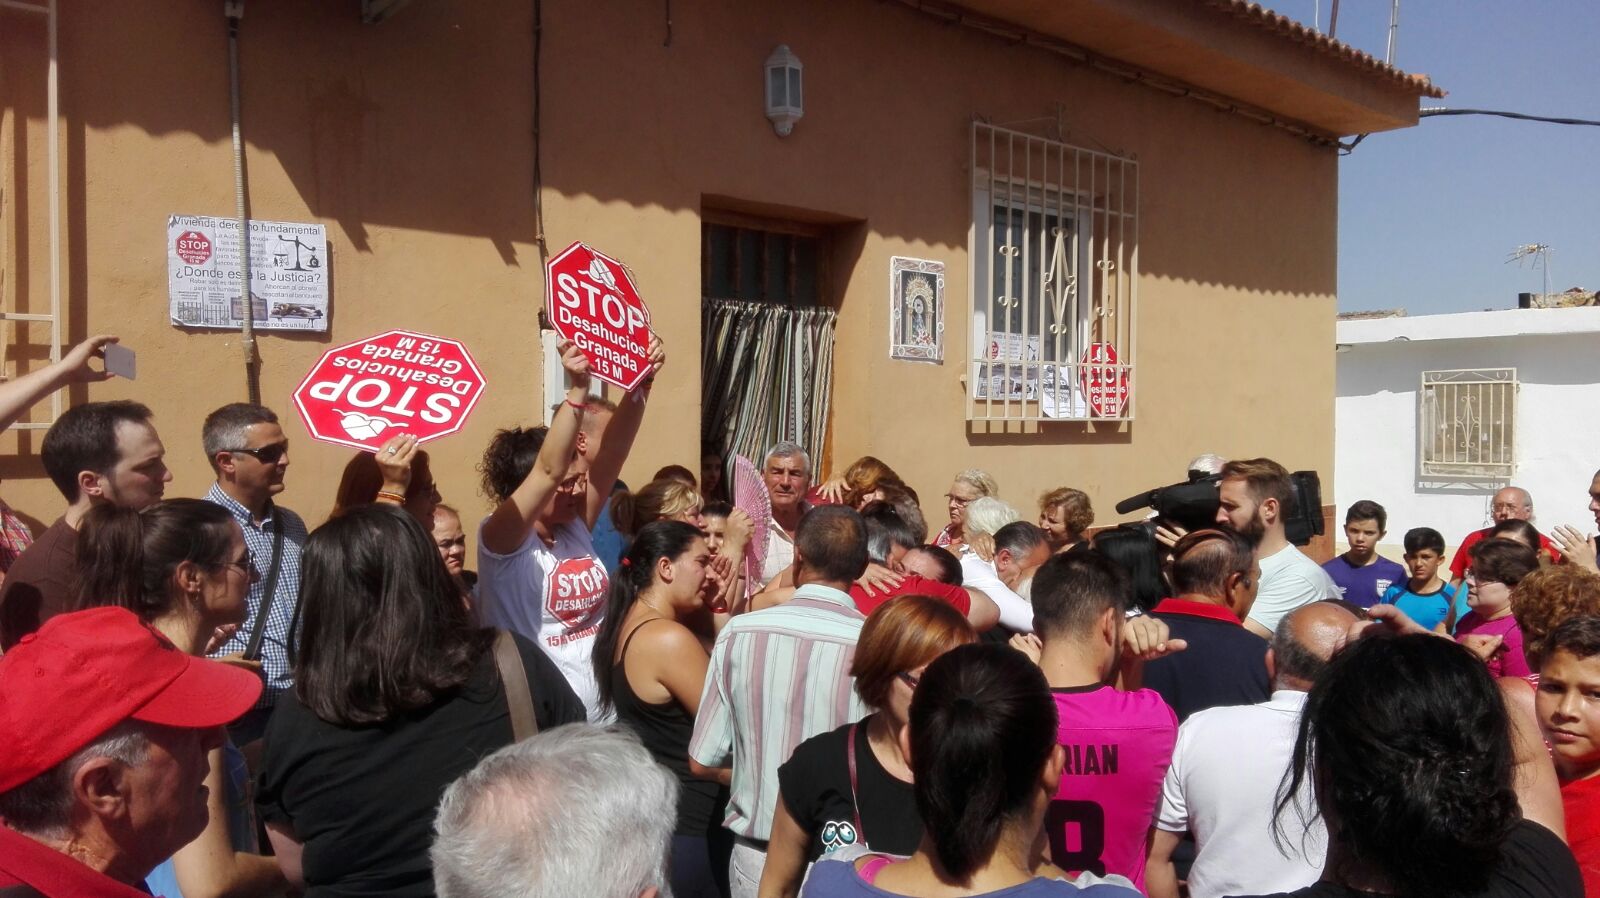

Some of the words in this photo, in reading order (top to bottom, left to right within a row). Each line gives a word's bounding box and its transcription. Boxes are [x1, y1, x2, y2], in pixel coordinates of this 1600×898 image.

[174, 216, 215, 228] Vivienda
[219, 220, 259, 232] dereho
[261, 223, 321, 236] fundamental
[179, 240, 209, 250] STOP
[175, 265, 224, 279] ¿Donde
[256, 270, 266, 281] la
[270, 271, 321, 283] Justicia?
[557, 272, 645, 335] STOP
[396, 337, 417, 349] M
[559, 305, 646, 358] Desahucios
[361, 343, 463, 375] Granada
[418, 341, 441, 355] 15
[573, 331, 638, 373] Granada
[332, 355, 473, 396] Desahucios
[595, 357, 610, 375] 15
[612, 364, 623, 380] M
[309, 373, 461, 424] STOP
[557, 566, 604, 598] STOP
[1060, 744, 1119, 776] RIAN
